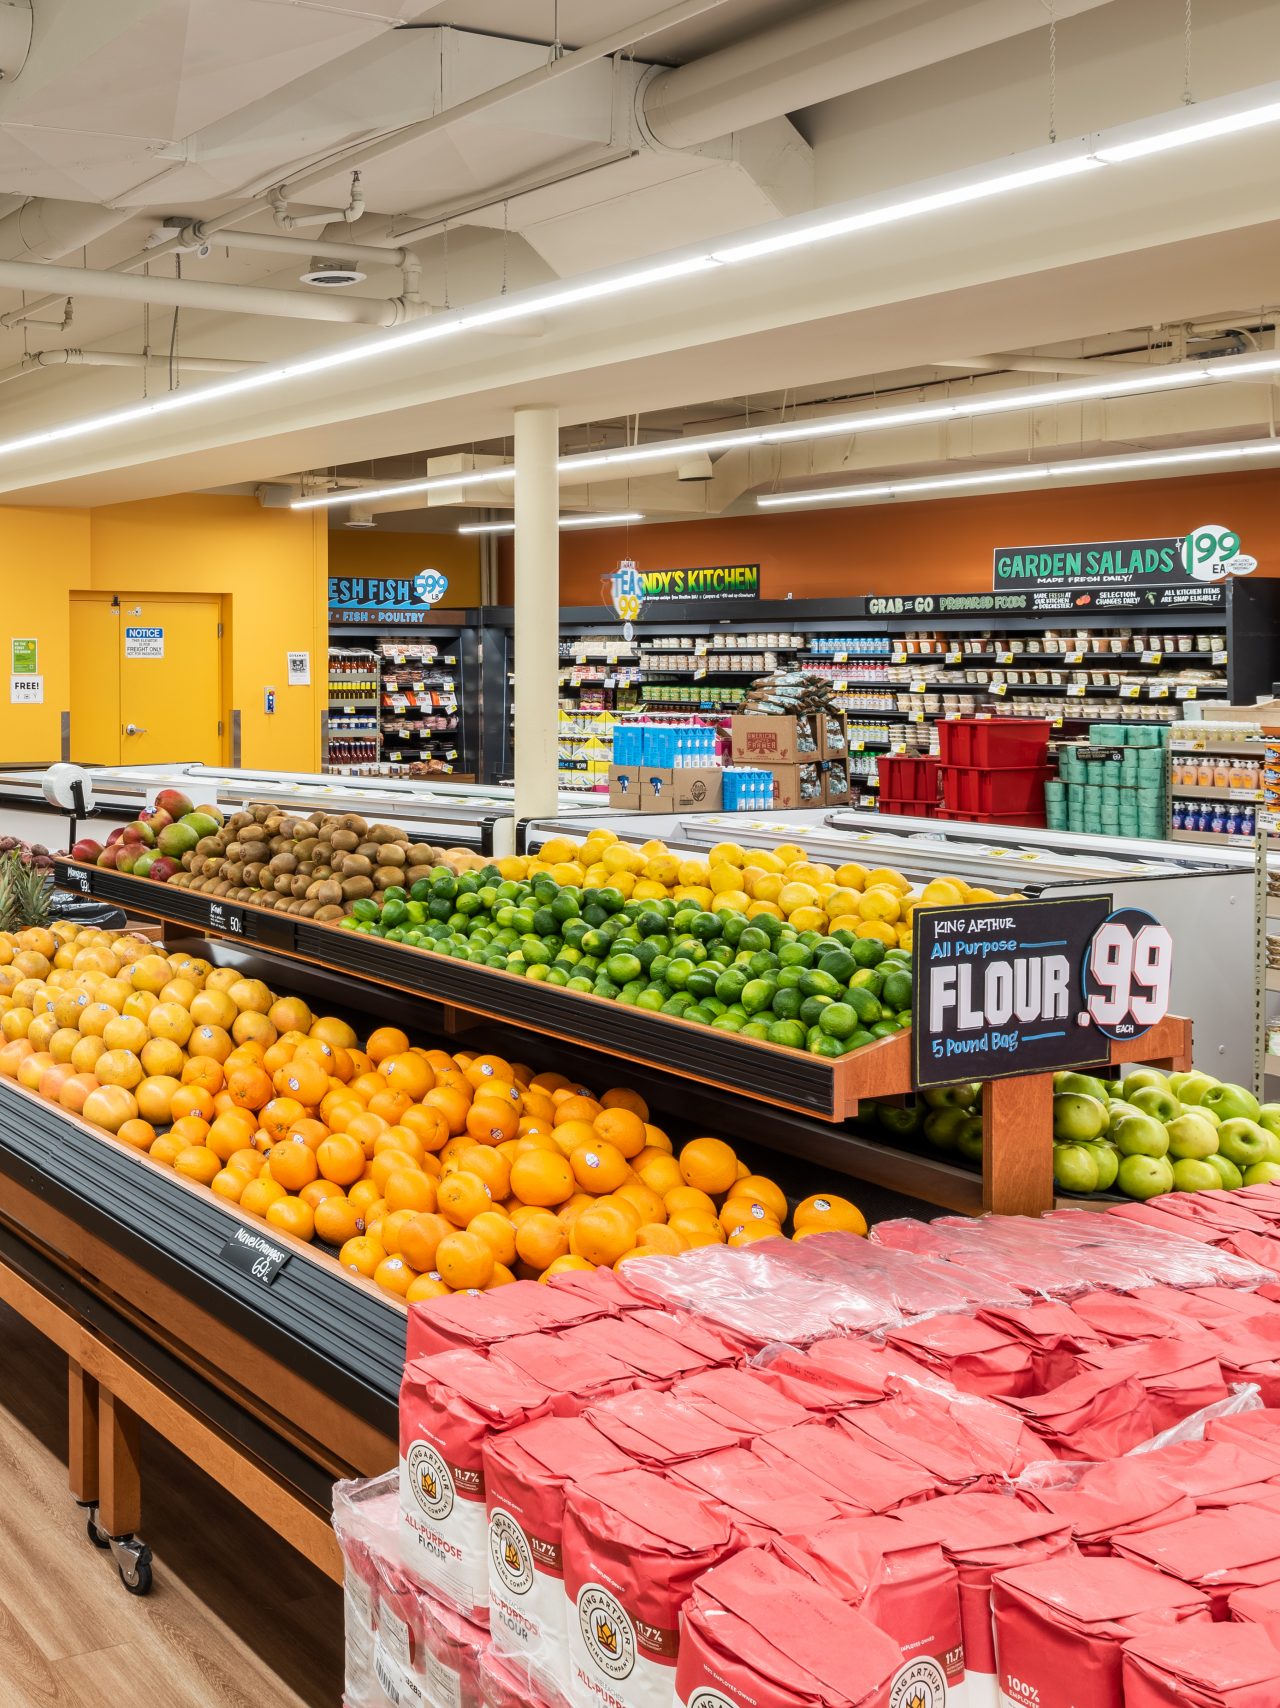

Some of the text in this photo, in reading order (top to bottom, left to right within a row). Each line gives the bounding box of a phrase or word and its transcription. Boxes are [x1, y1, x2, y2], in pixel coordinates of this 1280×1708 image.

[998, 548, 1175, 578] GARDEN SALADS
[368, 580, 409, 601] FISH
[414, 575, 449, 597] 599
[638, 567, 757, 594] NDY'S KITCHEN
[1103, 574, 1133, 582] DAILY!
[618, 595, 639, 620] 99
[870, 598, 903, 614] GRAB
[915, 597, 934, 613] GO
[939, 595, 1027, 611] PREPARED FOODS
[1100, 591, 1136, 599] SELECTION
[1191, 594, 1221, 602] ELIGIBLE!
[342, 611, 368, 621] FISH
[378, 612, 425, 622] POULTRY
[129, 628, 160, 637] NOTICE
[14, 682, 39, 690] FREE!
[934, 917, 1016, 938] KING ARTHUR
[930, 939, 1018, 960] All Purpose
[1077, 923, 1173, 1027] .99
[929, 954, 1070, 1033] FLOUR
[1115, 1024, 1134, 1033] EACH
[932, 1030, 1019, 1058] 5 Pound Bag
[234, 1228, 285, 1263] Navel Oranges
[411, 1450, 450, 1491] KING ARTHUR
[454, 1468, 480, 1483] 11.7%
[412, 1479, 449, 1515] BAKING COMPANY
[405, 1513, 462, 1561] ALL-PURPOSE
[418, 1534, 447, 1562] FLOUR
[502, 1520, 528, 1563] ARTHUR
[531, 1538, 556, 1557] 11.7%
[494, 1549, 530, 1588] BAKING COMPANY
[499, 1613, 529, 1642] FLOUR
[582, 1595, 631, 1646] KING ARTHUR
[635, 1621, 663, 1642] 11.7%
[584, 1628, 629, 1672] BAKING COMPANY
[578, 1668, 628, 1708] ALL-PURP
[713, 1673, 757, 1706] EMPLOYEE-OWNED
[910, 1667, 940, 1693] ARTHUR
[1007, 1674, 1040, 1703] 100%
